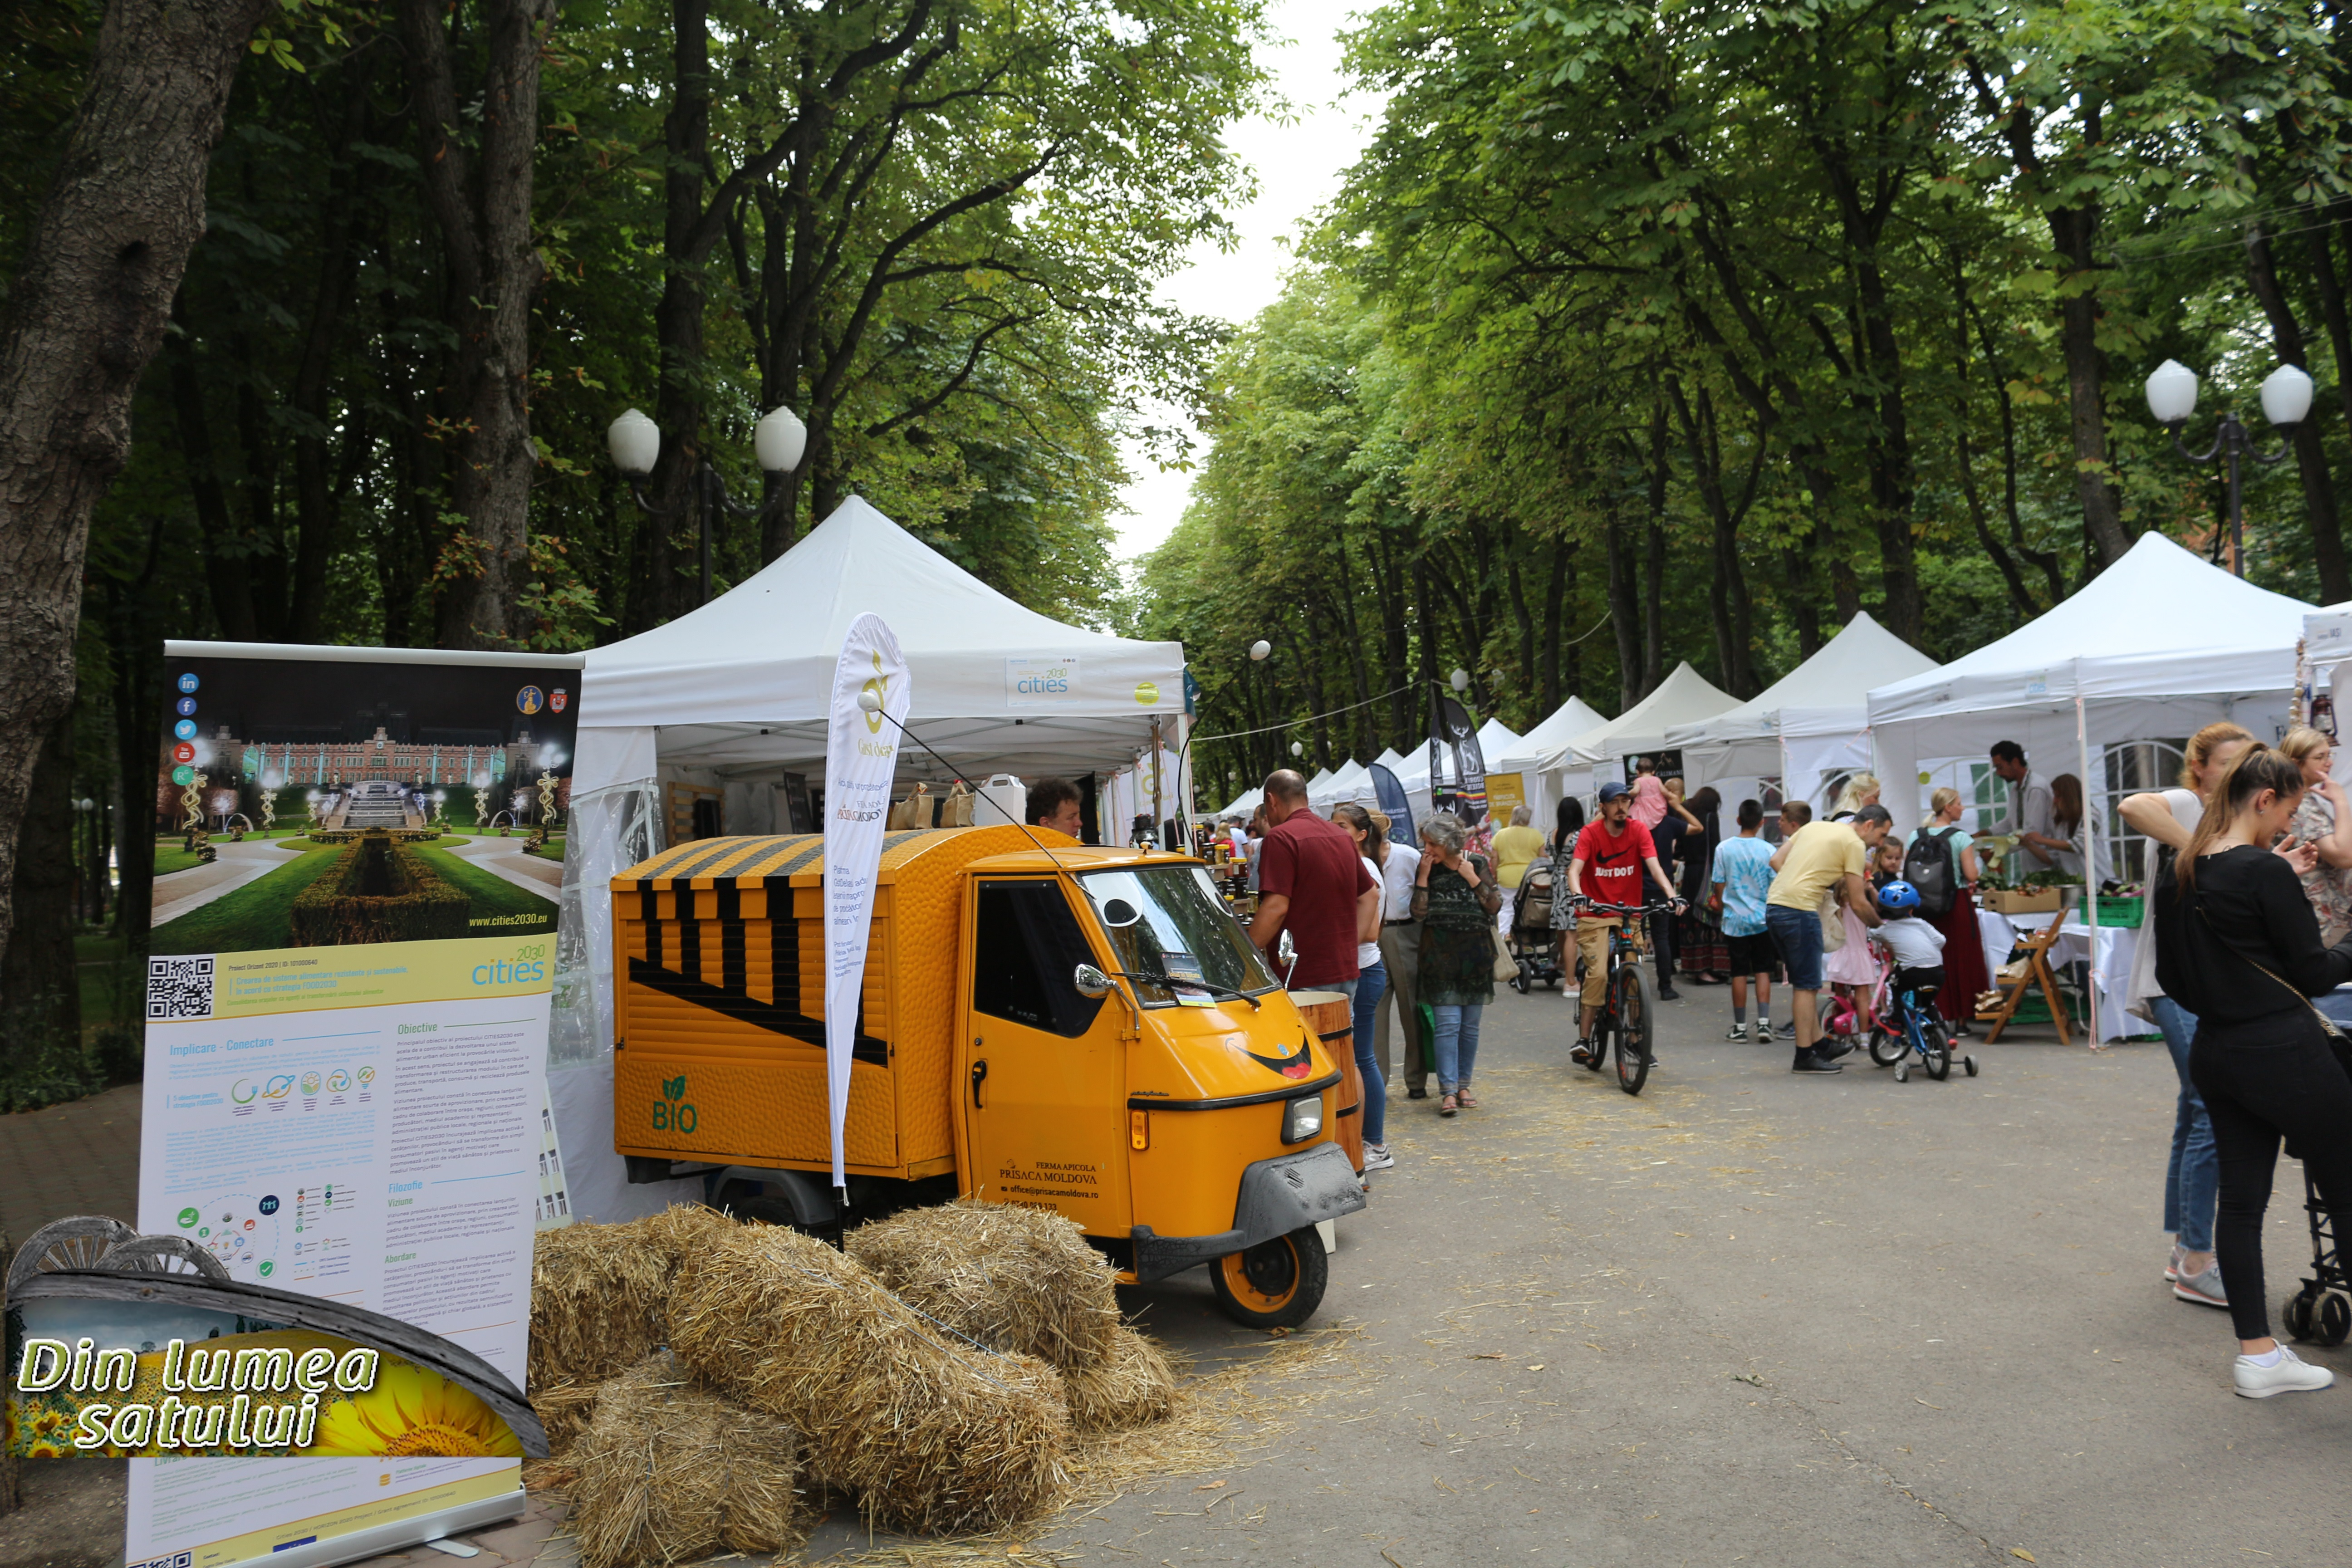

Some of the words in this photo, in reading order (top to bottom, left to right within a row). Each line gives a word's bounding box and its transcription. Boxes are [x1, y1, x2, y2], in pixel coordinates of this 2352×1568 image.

[1046, 668, 1068, 679] 2030
[182, 677, 195, 689] in
[1018, 676, 1068, 693] cities
[1595, 867, 1613, 877] JUST
[1614, 867, 1627, 877] DO
[469, 913, 547, 926] www.cities2030.eu
[516, 944, 545, 961] 2030
[236, 977, 261, 985] Crearea
[273, 974, 297, 982] sisteme
[299, 971, 333, 980] alimentare
[472, 958, 544, 985] cities
[244, 986, 262, 995] acord
[273, 983, 301, 992] strategia
[303, 980, 337, 990] FOOD2030
[397, 1022, 437, 1035] Obiective
[170, 1043, 216, 1057] Implicare
[227, 1037, 274, 1051] Conectare
[653, 1101, 697, 1133] BIO
[1036, 1162, 1061, 1170] FERMA
[1063, 1164, 1096, 1172] APICOLA
[1000, 1169, 1043, 1181] PRISACA
[1044, 1172, 1097, 1184] MOLDOVA
[388, 1180, 423, 1194] Filozofie
[1010, 1185, 1098, 1199] office@prisacamoldova.ro
[388, 1197, 413, 1208] Viziune
[385, 1251, 416, 1264] Abordare
[276, 1530, 293, 1540] Cities
[294, 1528, 309, 1536] 2030
[339, 1518, 353, 1526] 2020
